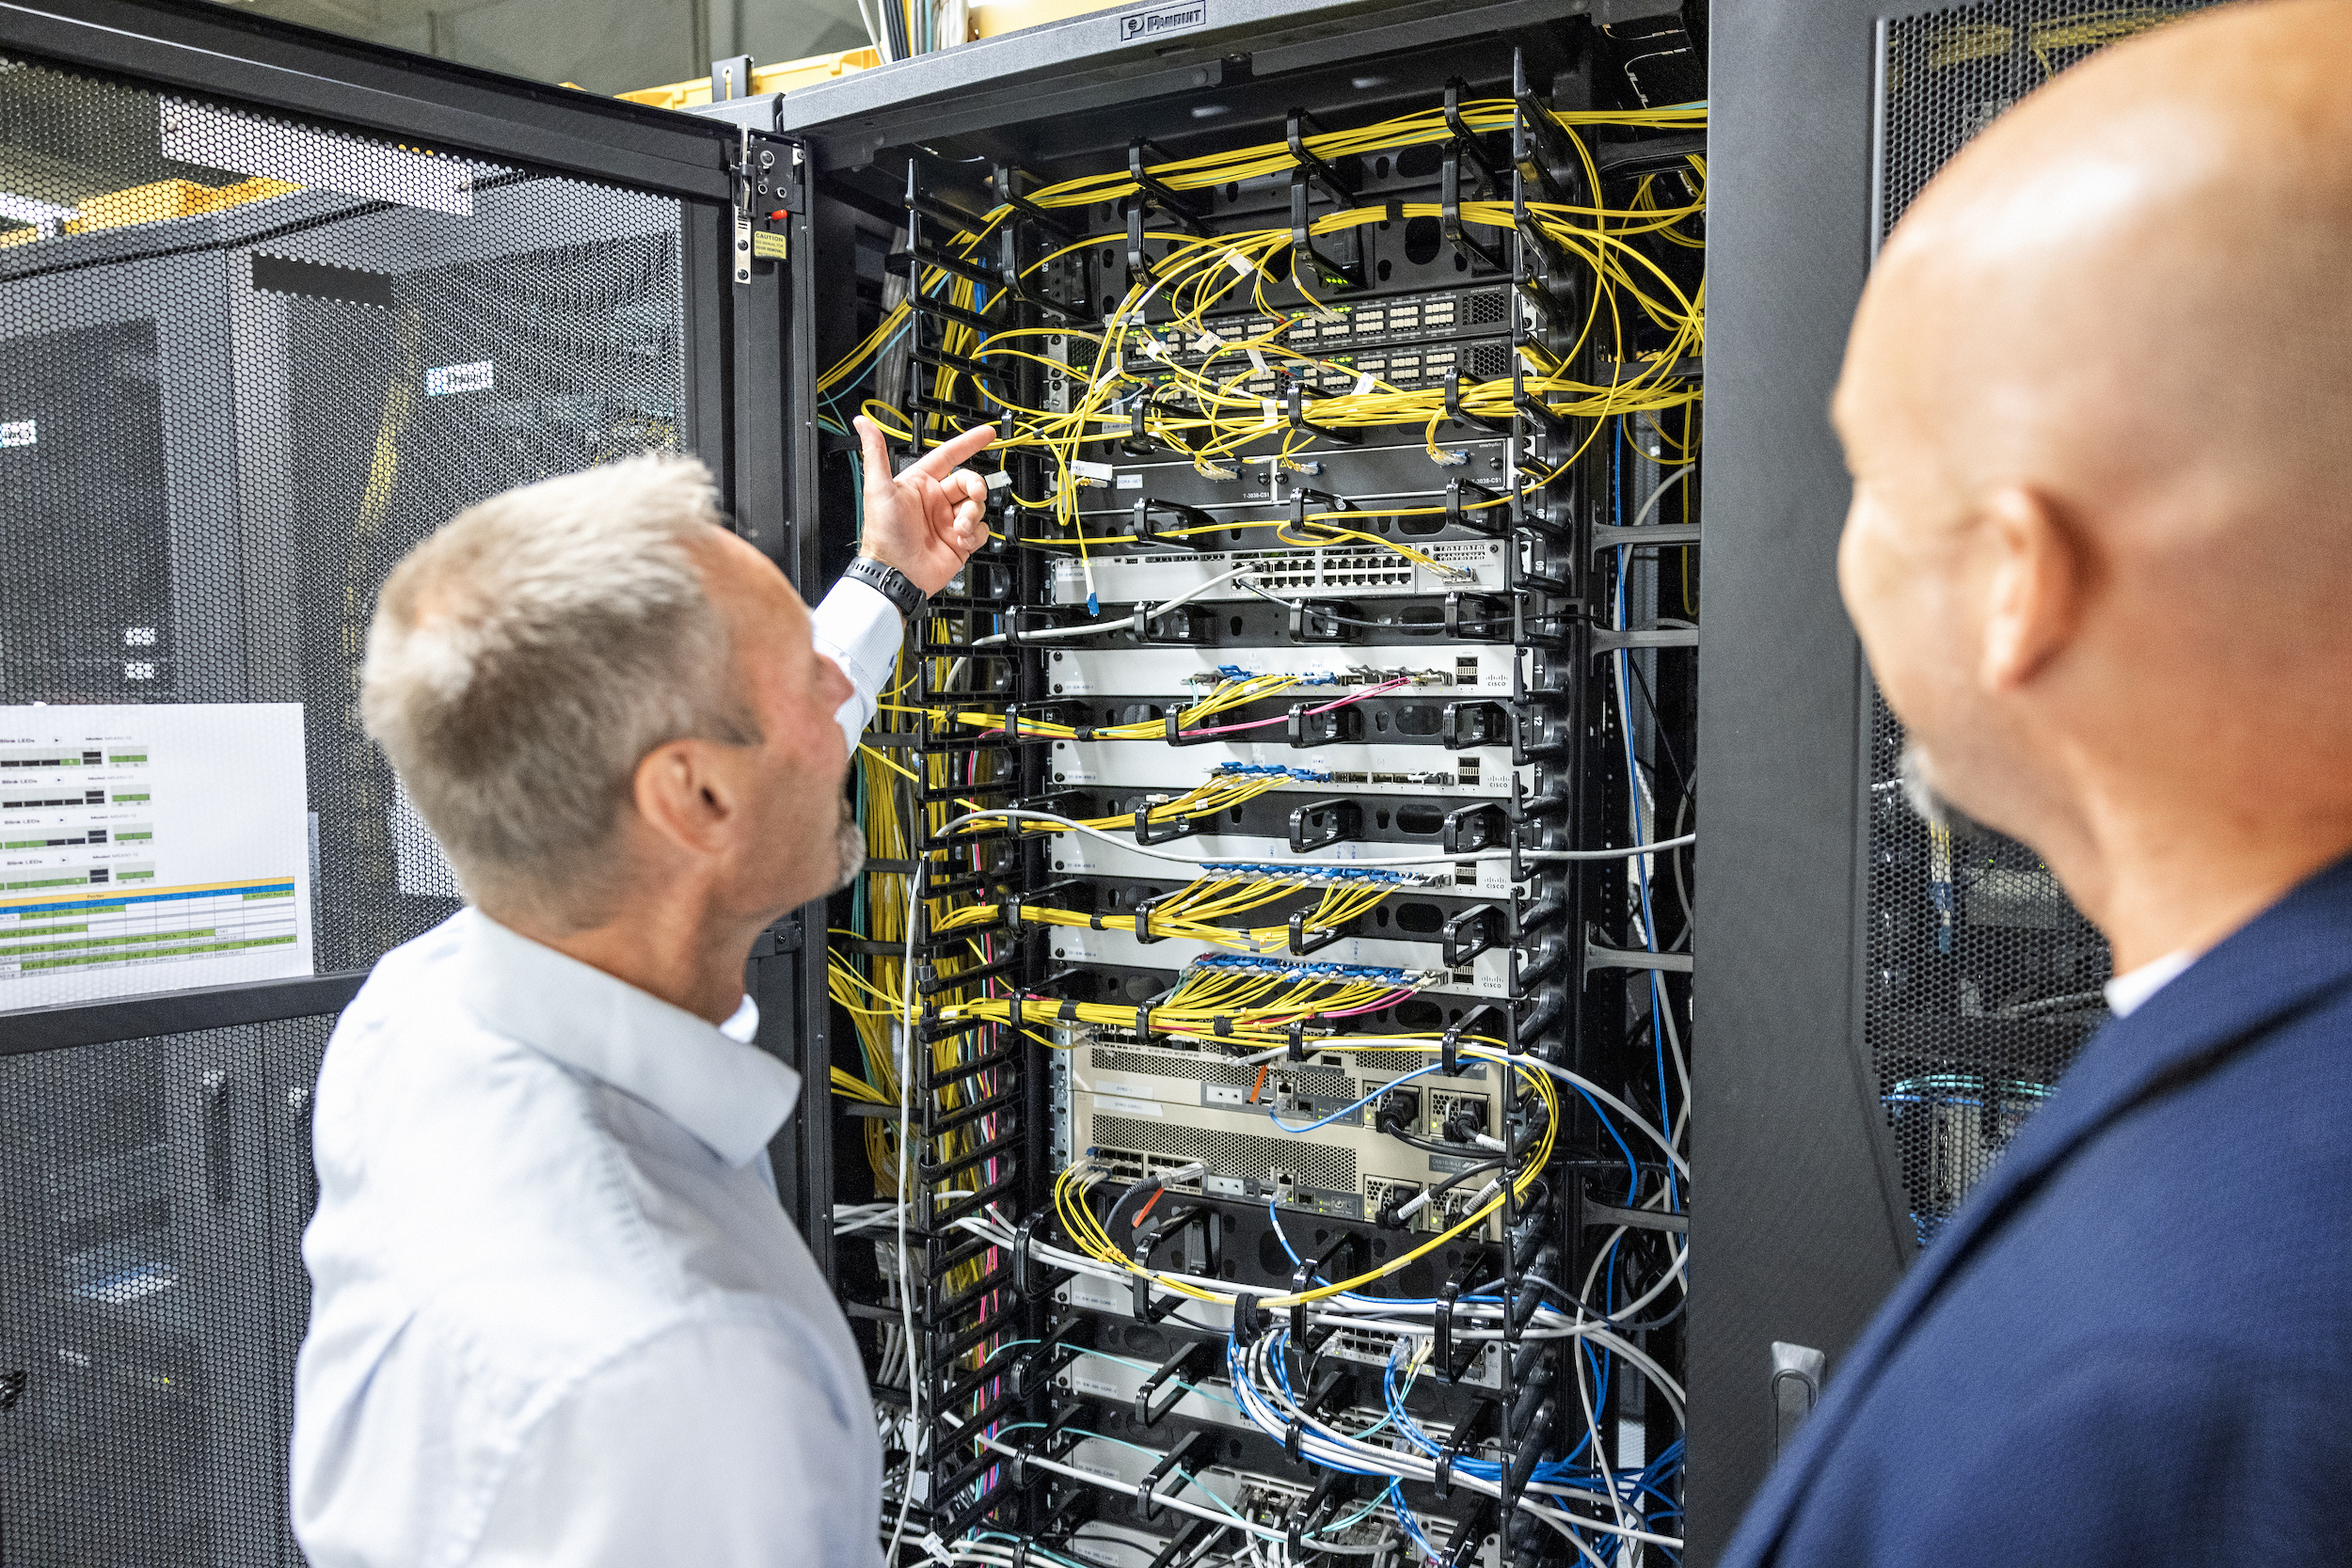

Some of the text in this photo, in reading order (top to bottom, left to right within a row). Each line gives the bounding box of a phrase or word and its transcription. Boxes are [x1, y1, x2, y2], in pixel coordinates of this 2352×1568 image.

[1147, 9, 1201, 32] PANDUIT
[755, 233, 783, 242] CAUTION
[1535, 560, 1544, 571] 09
[1534, 664, 1544, 674] 11
[1046, 712, 1053, 721] 12
[1534, 715, 1543, 726] 12
[1533, 818, 1541, 828] 14
